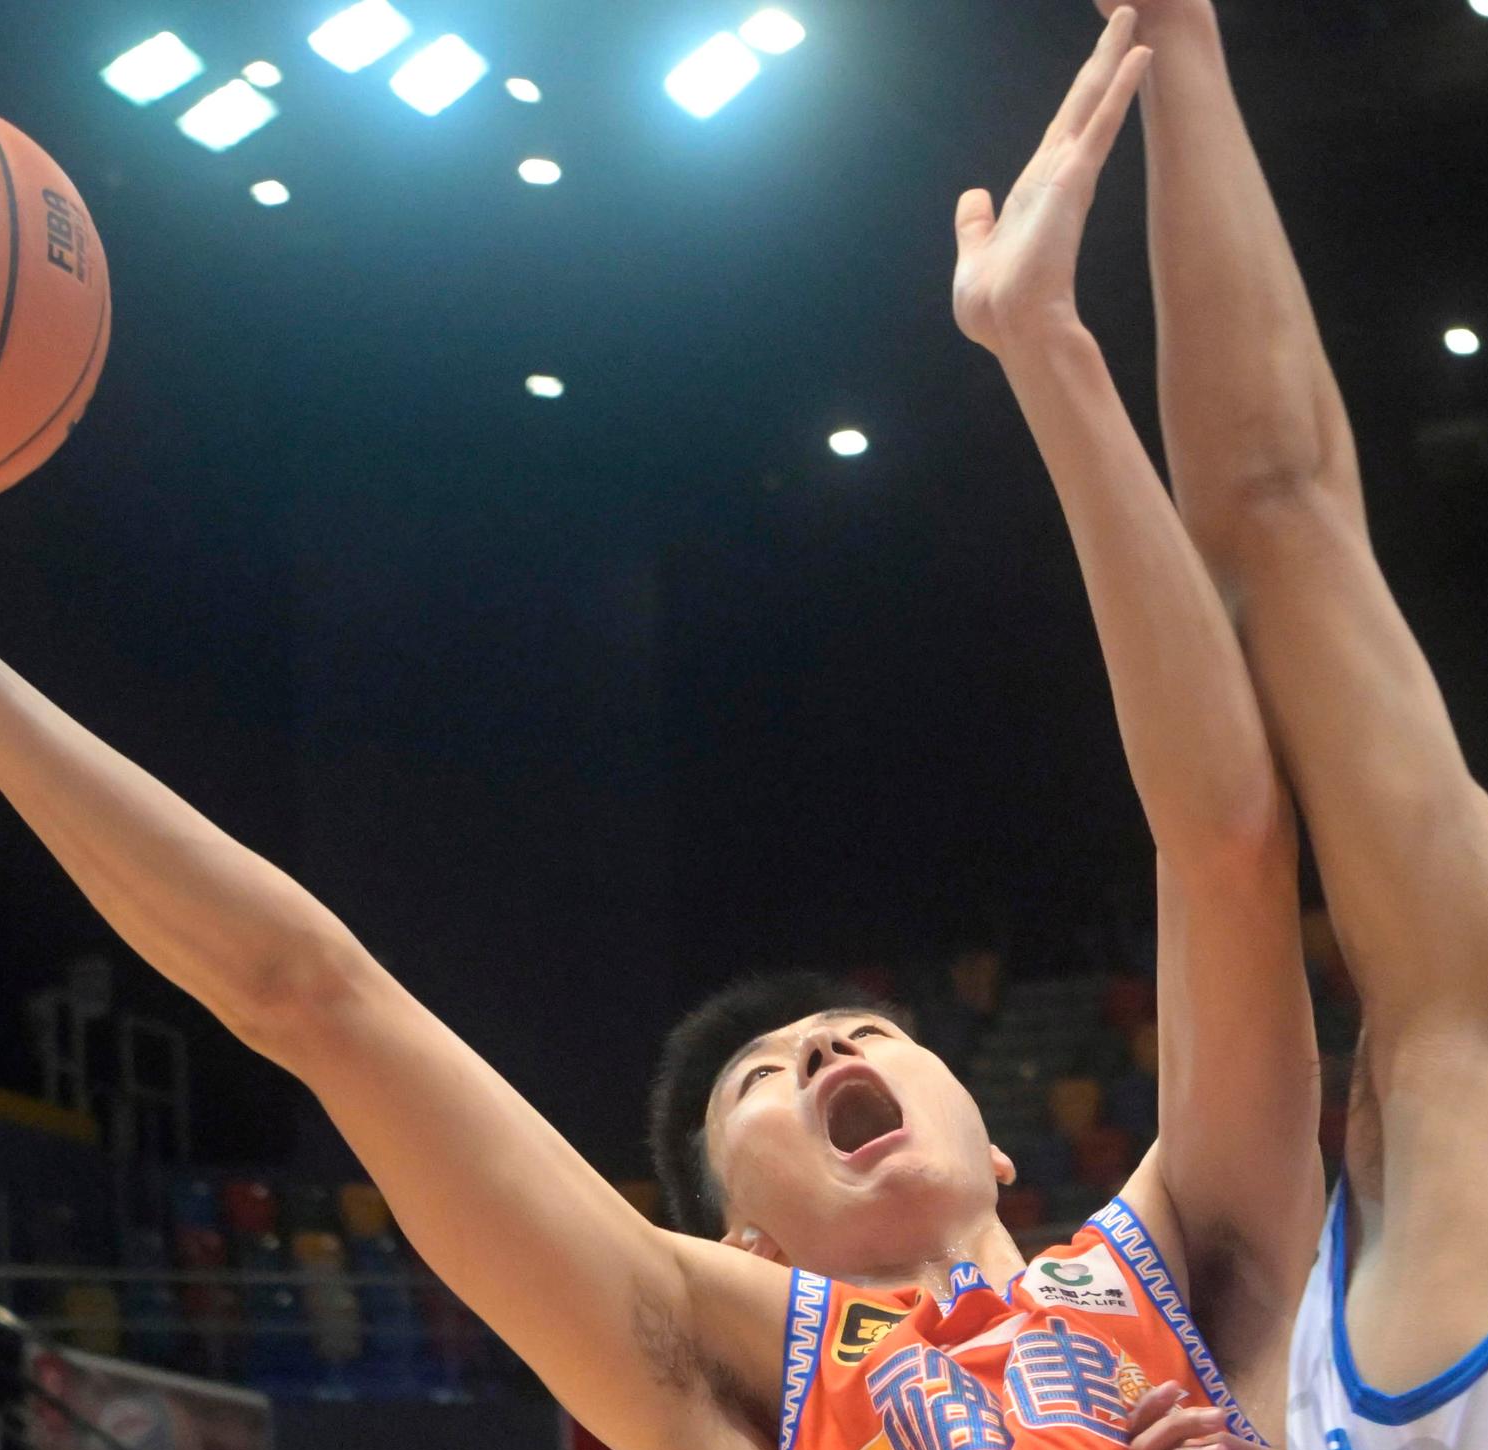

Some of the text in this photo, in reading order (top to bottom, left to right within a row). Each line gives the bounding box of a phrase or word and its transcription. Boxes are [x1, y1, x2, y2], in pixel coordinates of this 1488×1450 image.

[42, 188, 73, 273] FIBA
[1044, 1293, 1088, 1306] CHINA
[1095, 1299, 1128, 1307] LIFE
